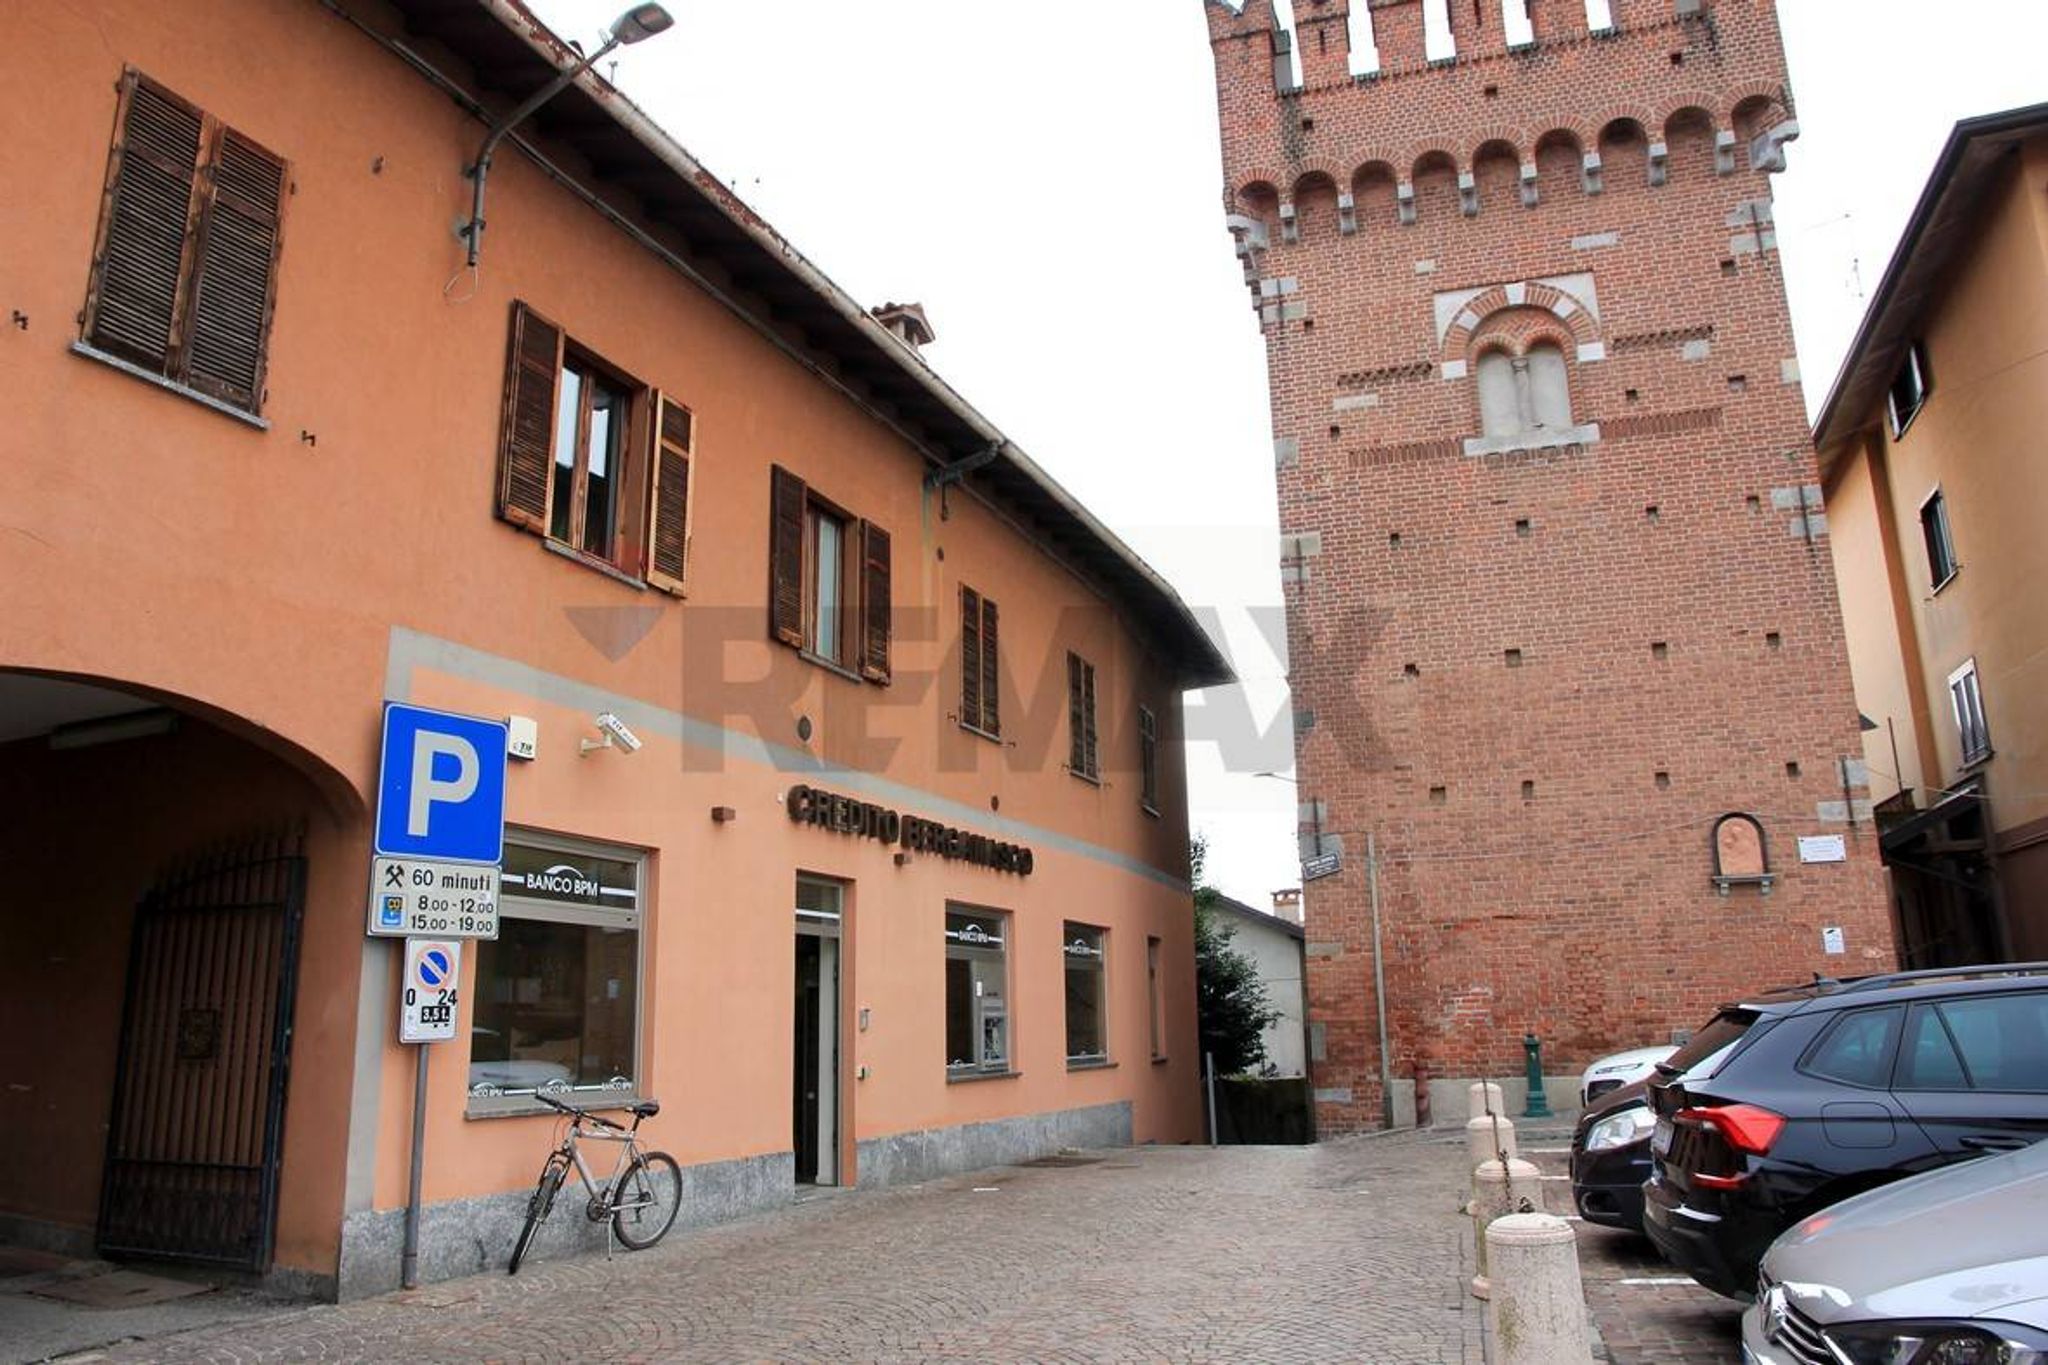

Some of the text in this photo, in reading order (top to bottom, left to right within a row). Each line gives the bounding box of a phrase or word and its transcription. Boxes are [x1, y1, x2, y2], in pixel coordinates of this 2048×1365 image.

[406, 729, 480, 837] P
[787, 784, 899, 845] CREDITO
[412, 868, 491, 891] 60 minuti
[526, 873, 598, 896] BANCO BPM
[405, 988, 458, 1006] 0 24
